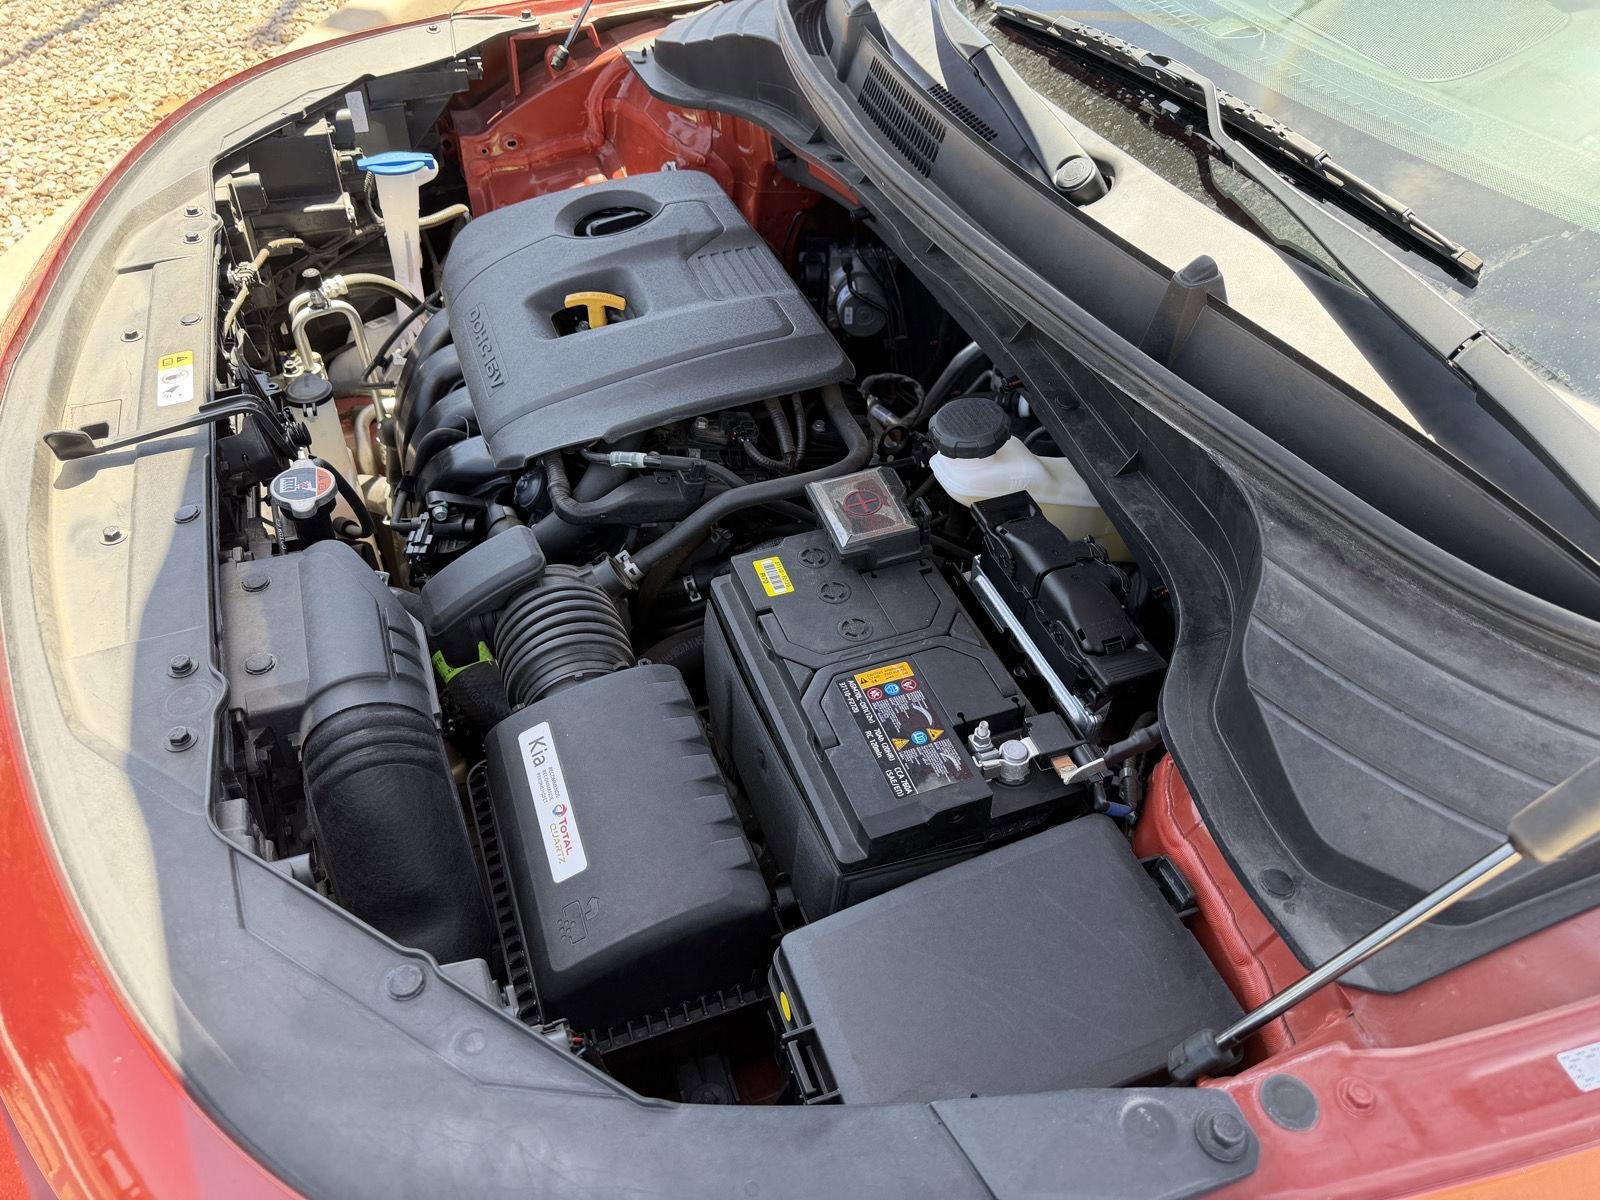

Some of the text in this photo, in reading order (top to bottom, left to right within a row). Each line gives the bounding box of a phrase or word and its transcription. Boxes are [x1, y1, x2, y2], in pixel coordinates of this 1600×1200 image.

[469, 306, 493, 358] DOHC
[528, 736, 547, 768] Kia
[864, 731, 873, 739] RC
[893, 767, 905, 779] CCA
[549, 823, 565, 865] QUARTZ
[558, 817, 573, 856] TOTAL
